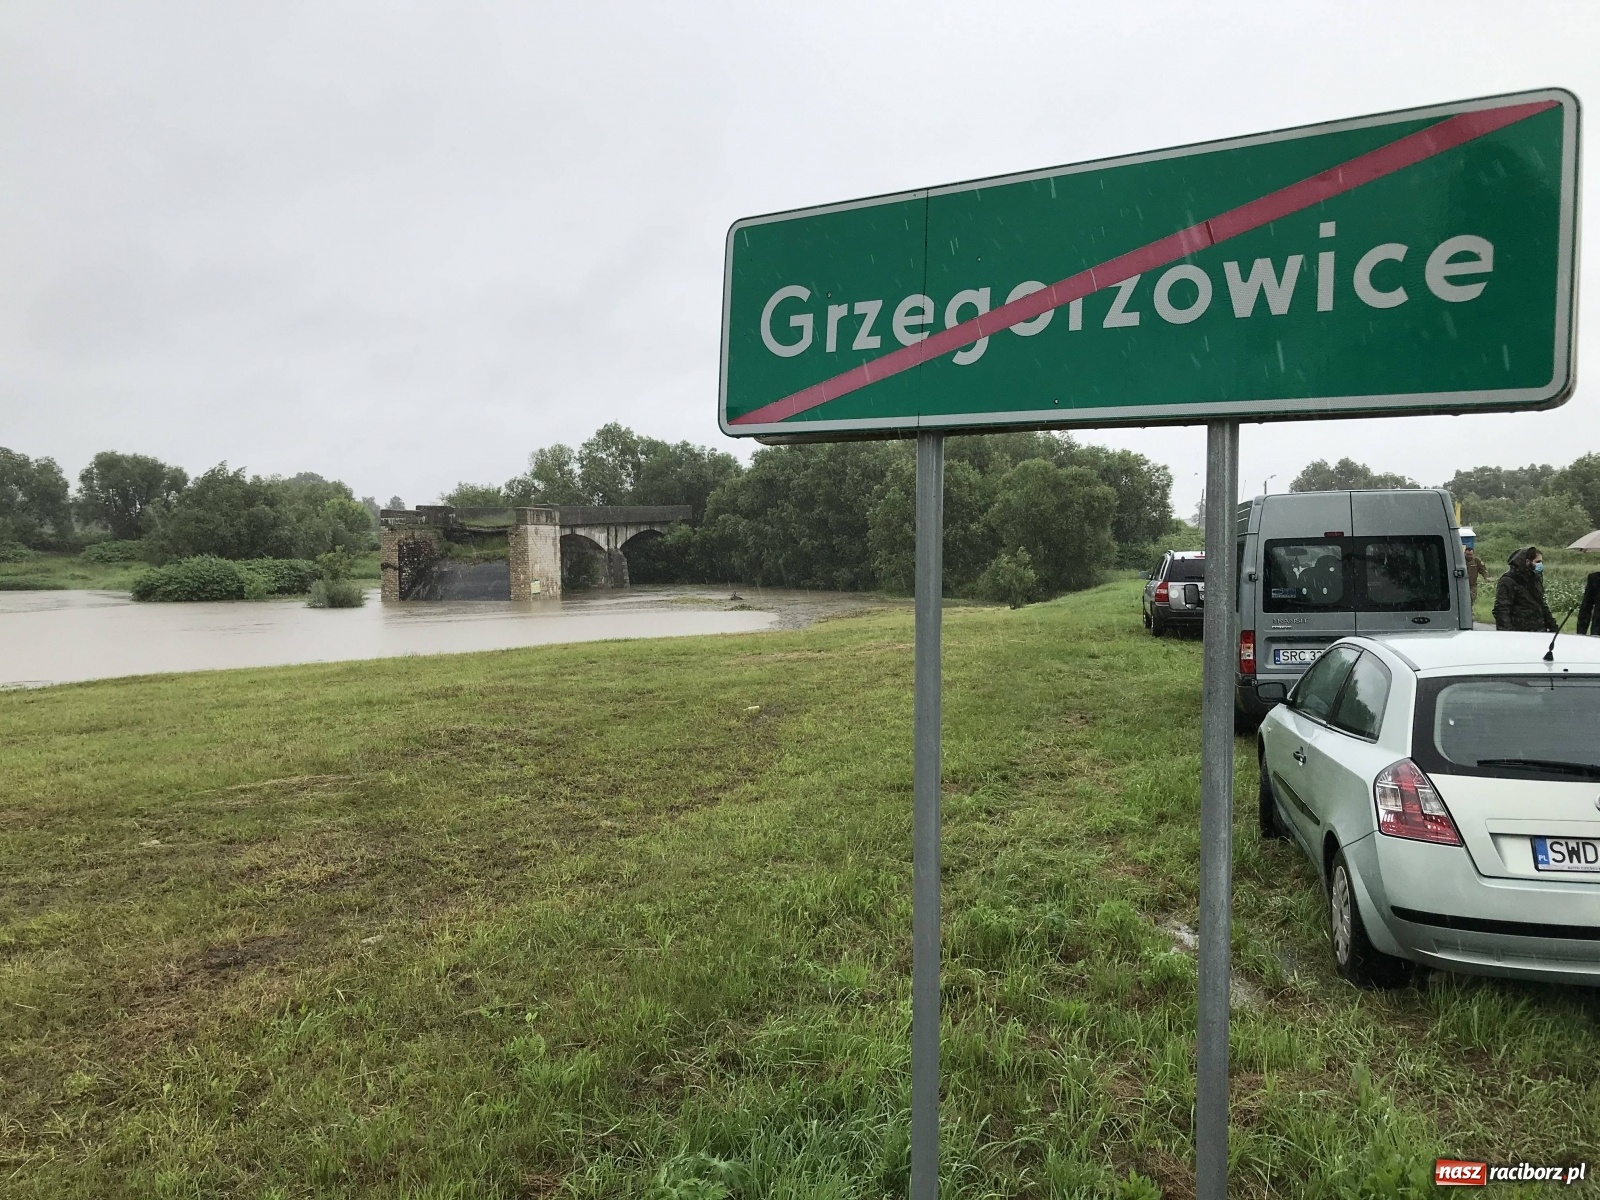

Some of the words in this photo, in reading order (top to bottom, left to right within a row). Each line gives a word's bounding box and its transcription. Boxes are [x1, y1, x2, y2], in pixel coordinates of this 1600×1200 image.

[759, 221, 1495, 365] Grzegorzowice
[1282, 651, 1306, 661] SRC
[1549, 841, 1599, 864] SWD
